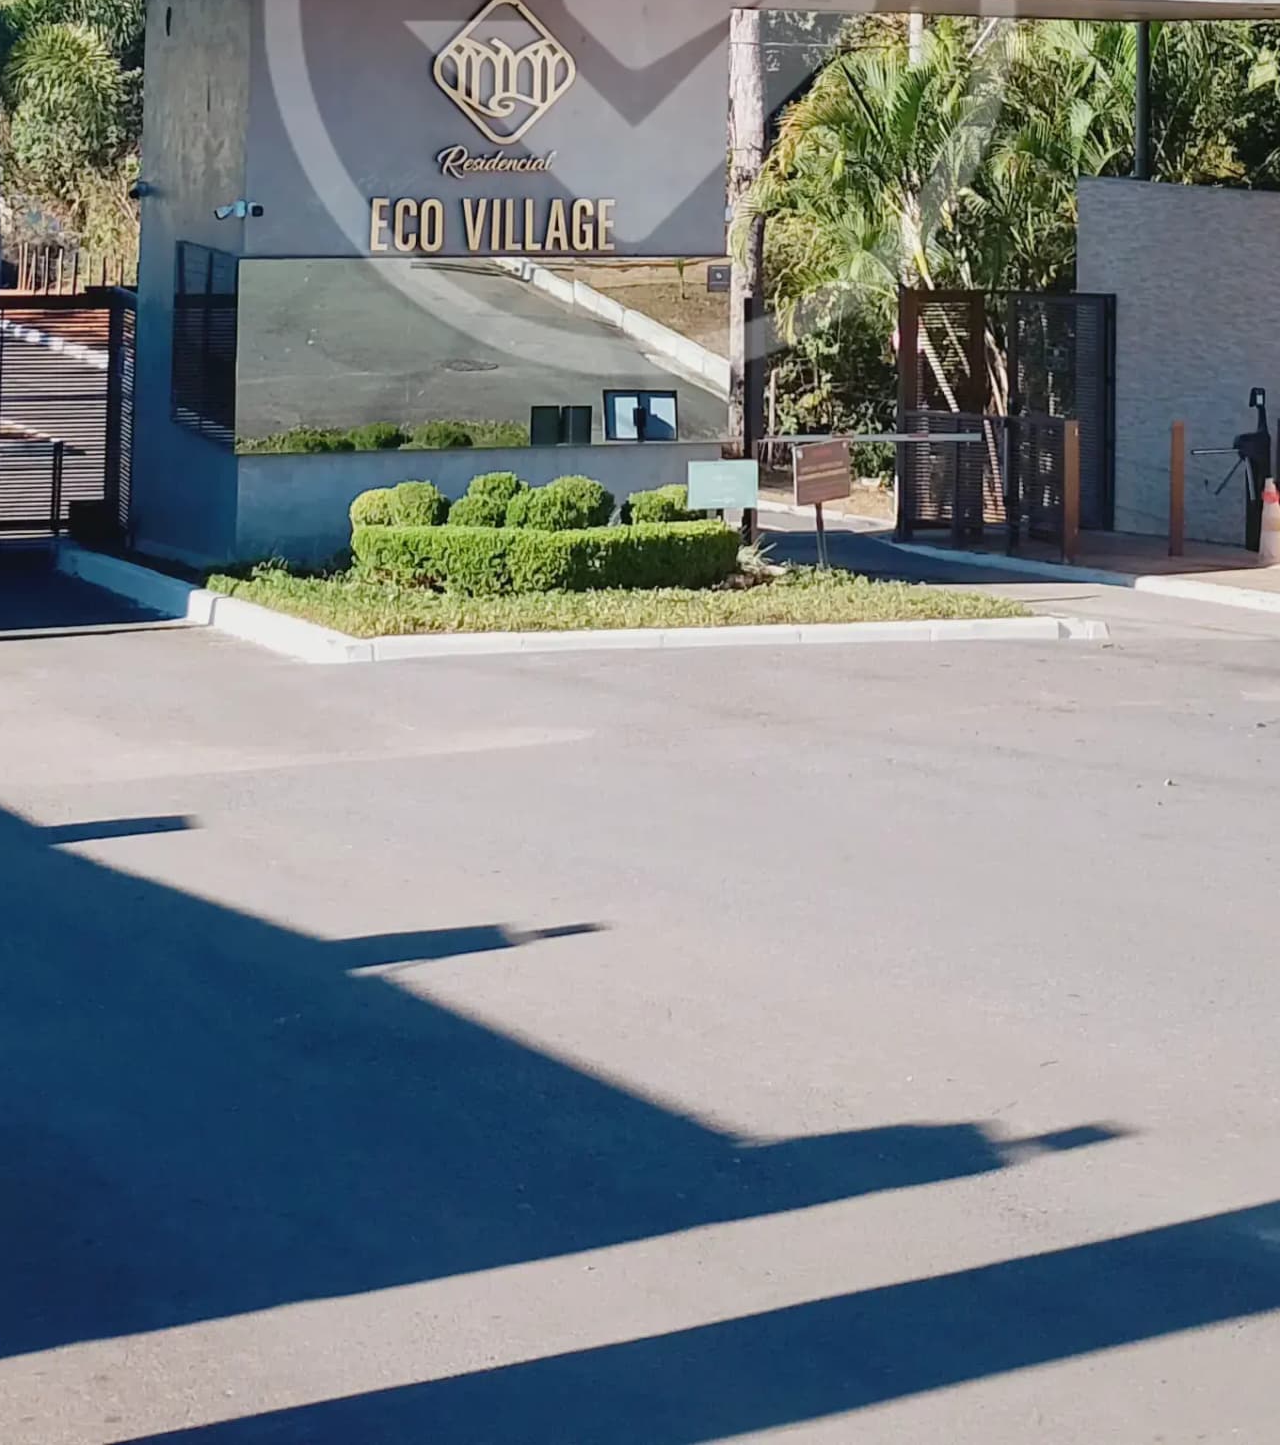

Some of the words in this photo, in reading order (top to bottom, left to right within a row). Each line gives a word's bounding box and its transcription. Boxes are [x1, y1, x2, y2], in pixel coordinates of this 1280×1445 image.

[436, 145, 558, 179] Residencial
[370, 197, 444, 252] ECO
[462, 197, 617, 252] VILLAGE
